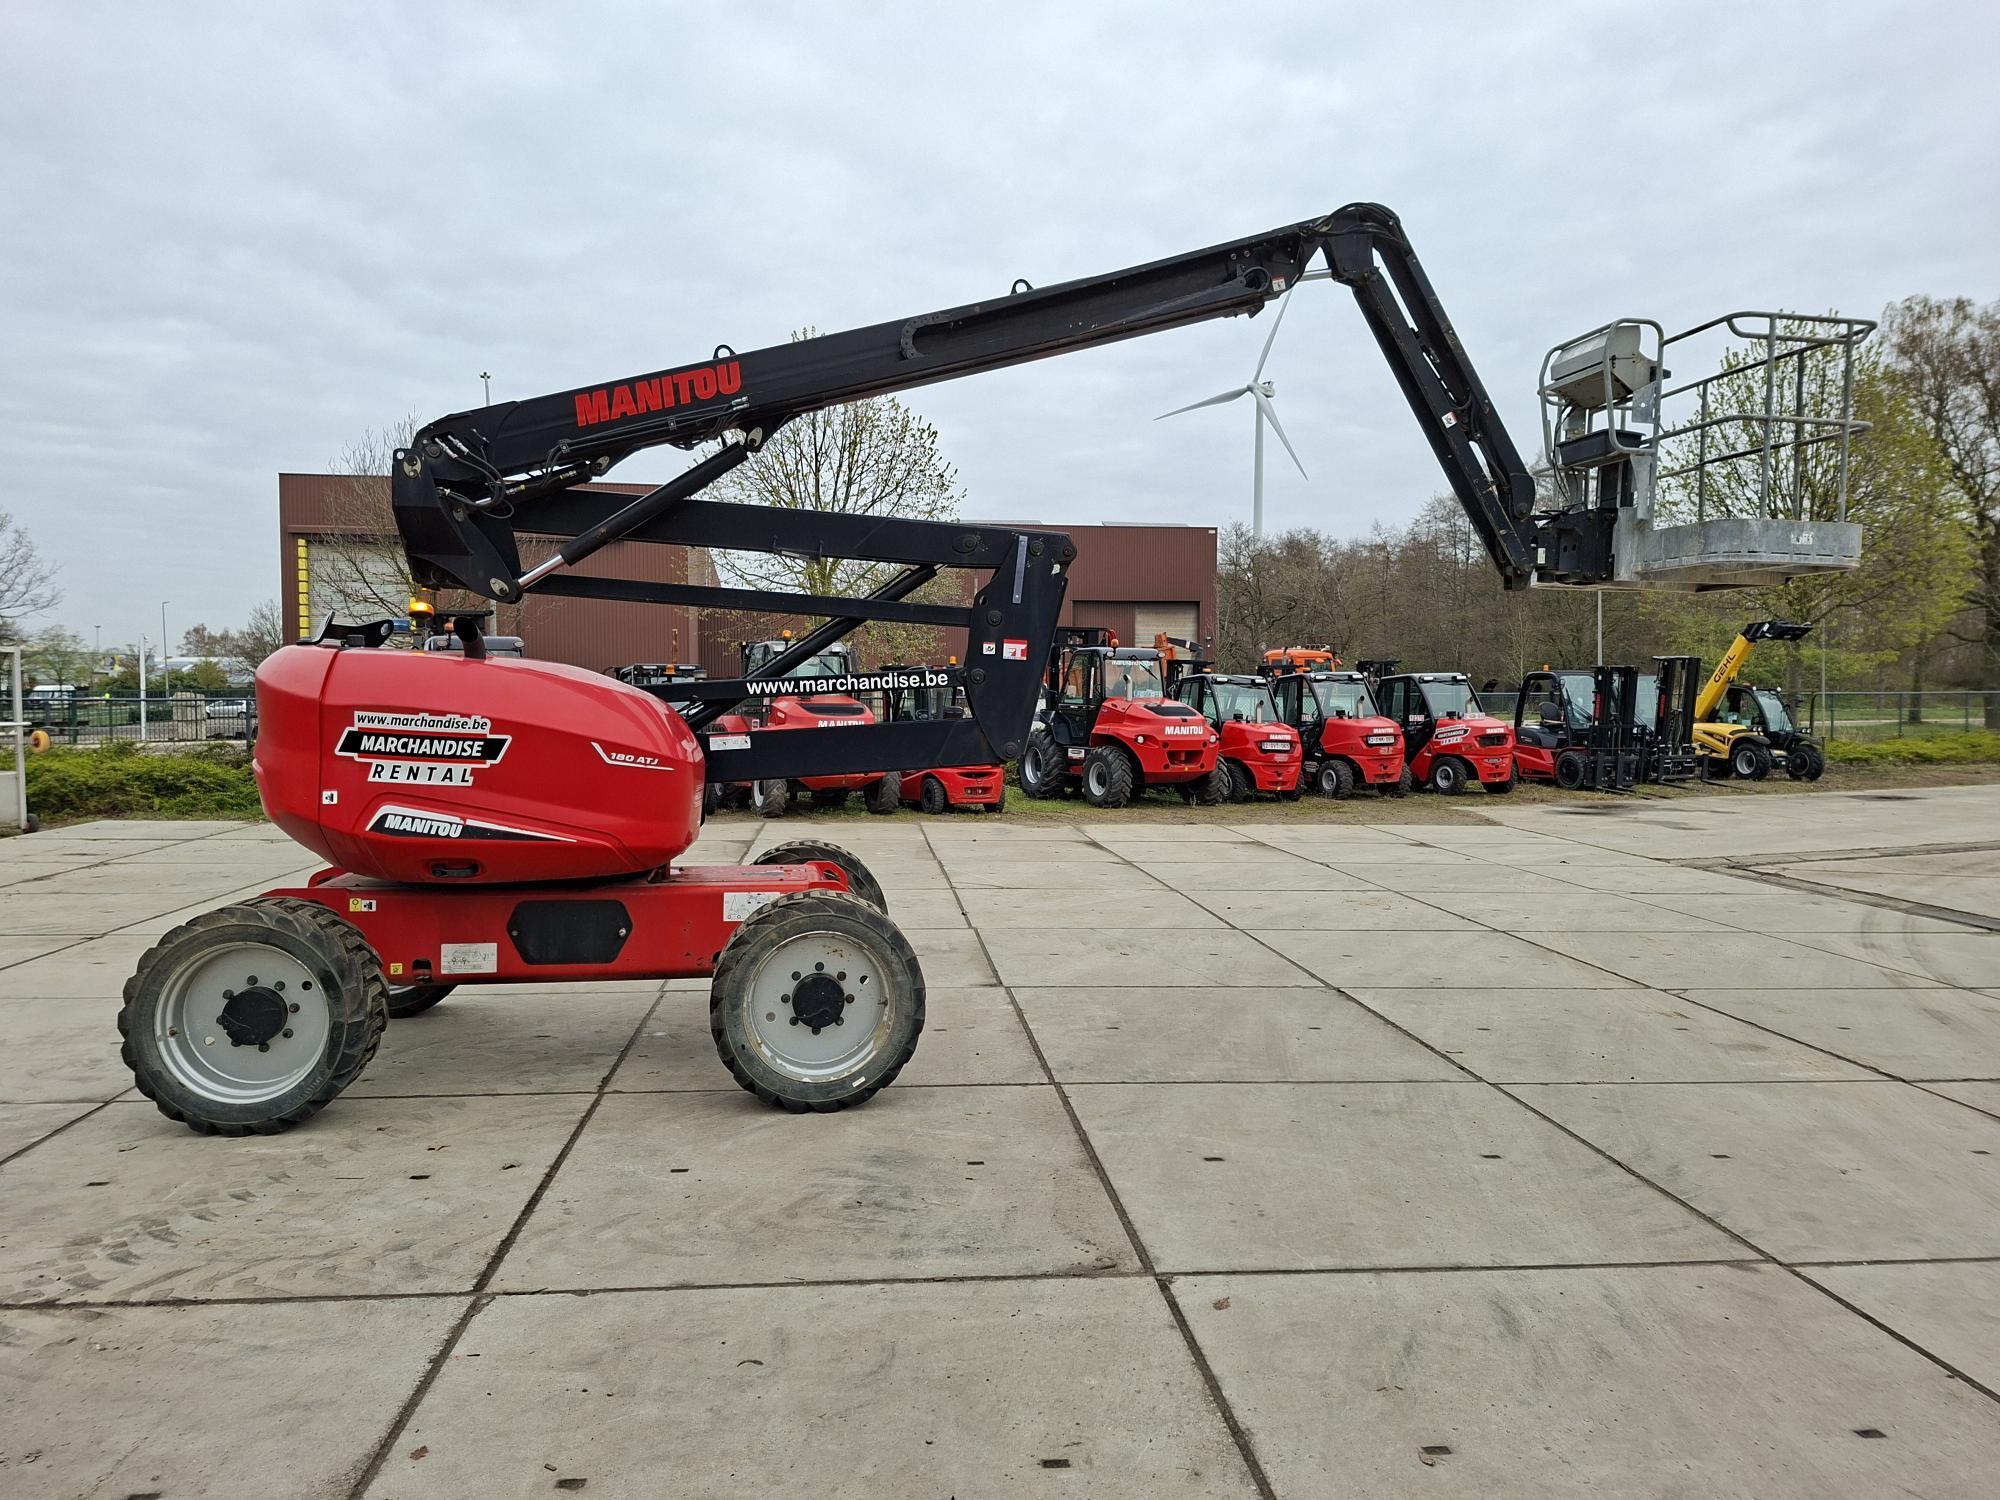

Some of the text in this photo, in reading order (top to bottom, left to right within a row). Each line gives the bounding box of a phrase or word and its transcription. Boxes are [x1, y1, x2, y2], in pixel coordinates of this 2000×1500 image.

[575, 361, 742, 427] MANITOU
[1713, 654, 1737, 683] GEHL
[746, 670, 949, 695] www.marchandise.be
[357, 714, 488, 730] www.marchandise.be
[1165, 726, 1203, 735] MANITOU
[360, 735, 484, 756] MARCHANDISE
[610, 752, 659, 765] 180 ATJ
[372, 763, 470, 783] RENTAL
[384, 815, 463, 838] MANITOU
